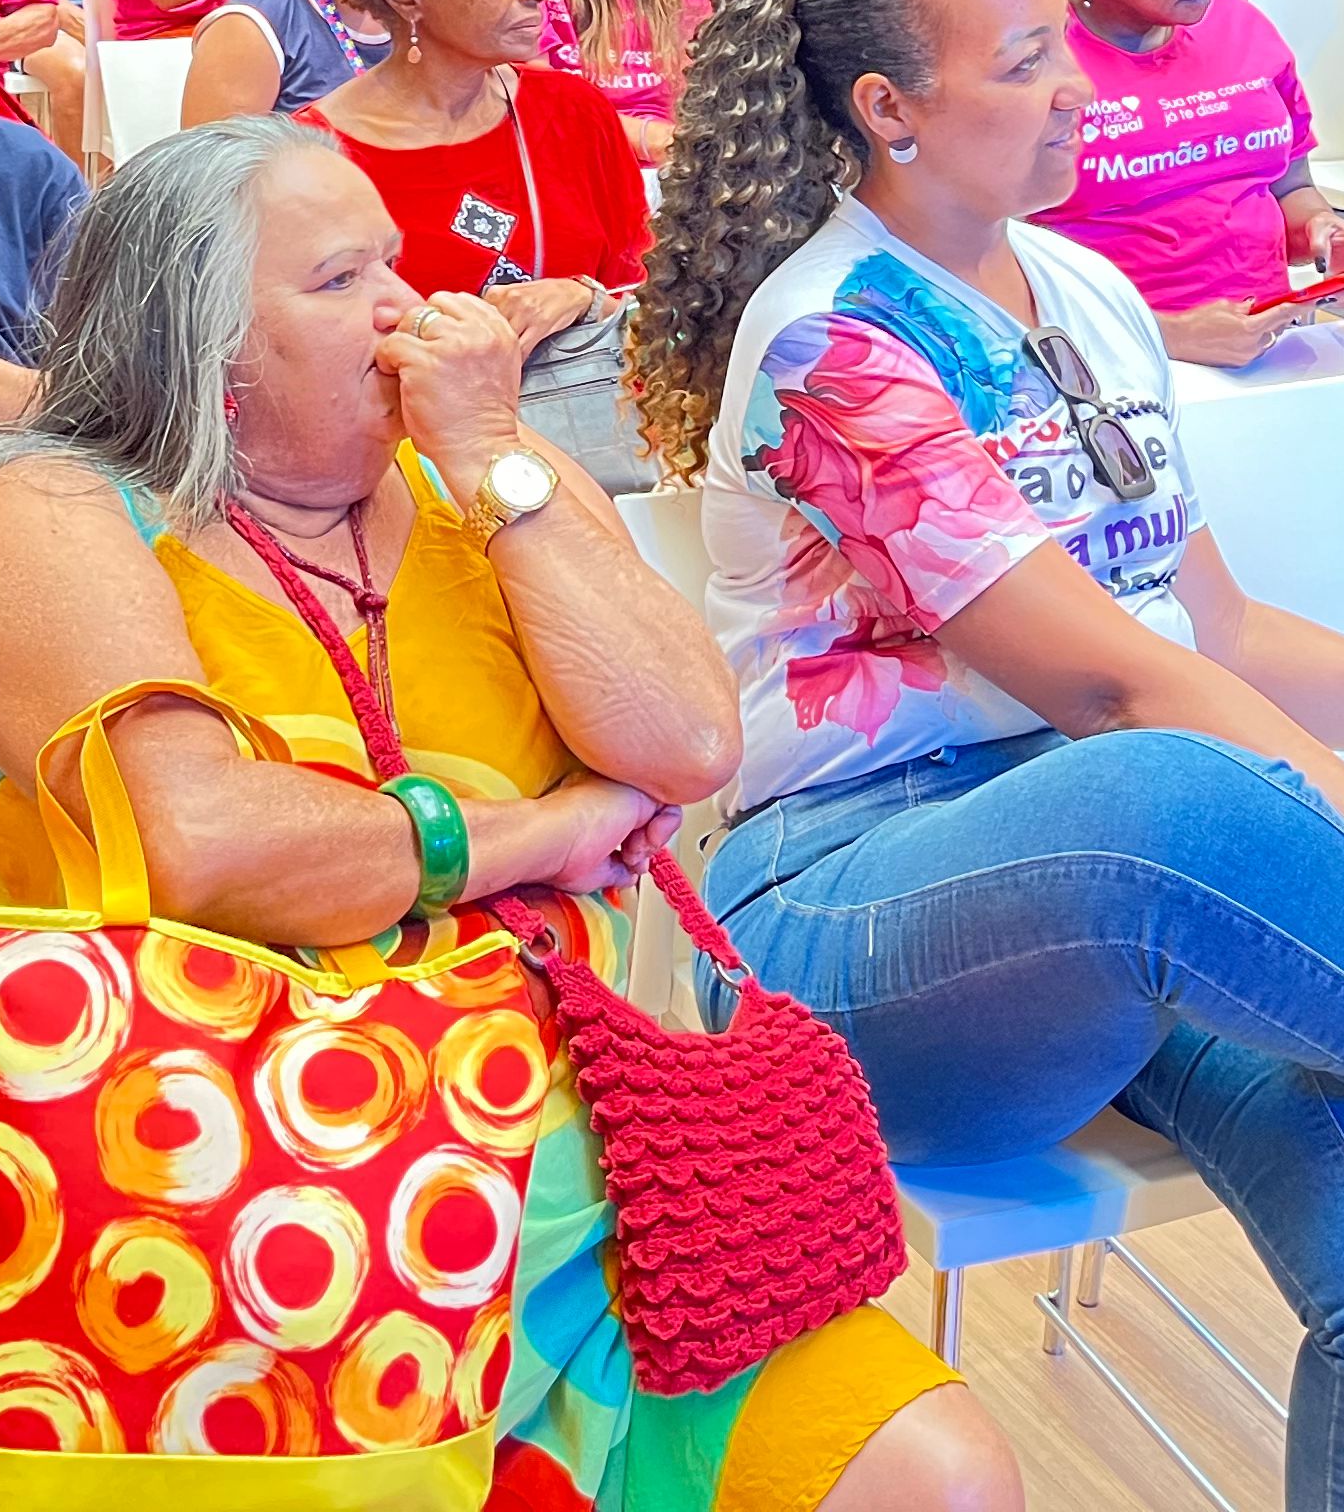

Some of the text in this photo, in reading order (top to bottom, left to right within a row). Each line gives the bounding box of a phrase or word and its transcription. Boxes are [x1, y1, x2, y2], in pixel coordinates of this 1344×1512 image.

[1084, 99, 1122, 118] Mãe
[1158, 97, 1186, 111] Sua
[1187, 90, 1217, 105] mãe
[1217, 83, 1245, 97] com
[1102, 116, 1145, 140] igual
[1103, 109, 1134, 125] tudo
[1164, 111, 1179, 128] já
[1180, 105, 1195, 120] te
[1213, 134, 1239, 158] te
